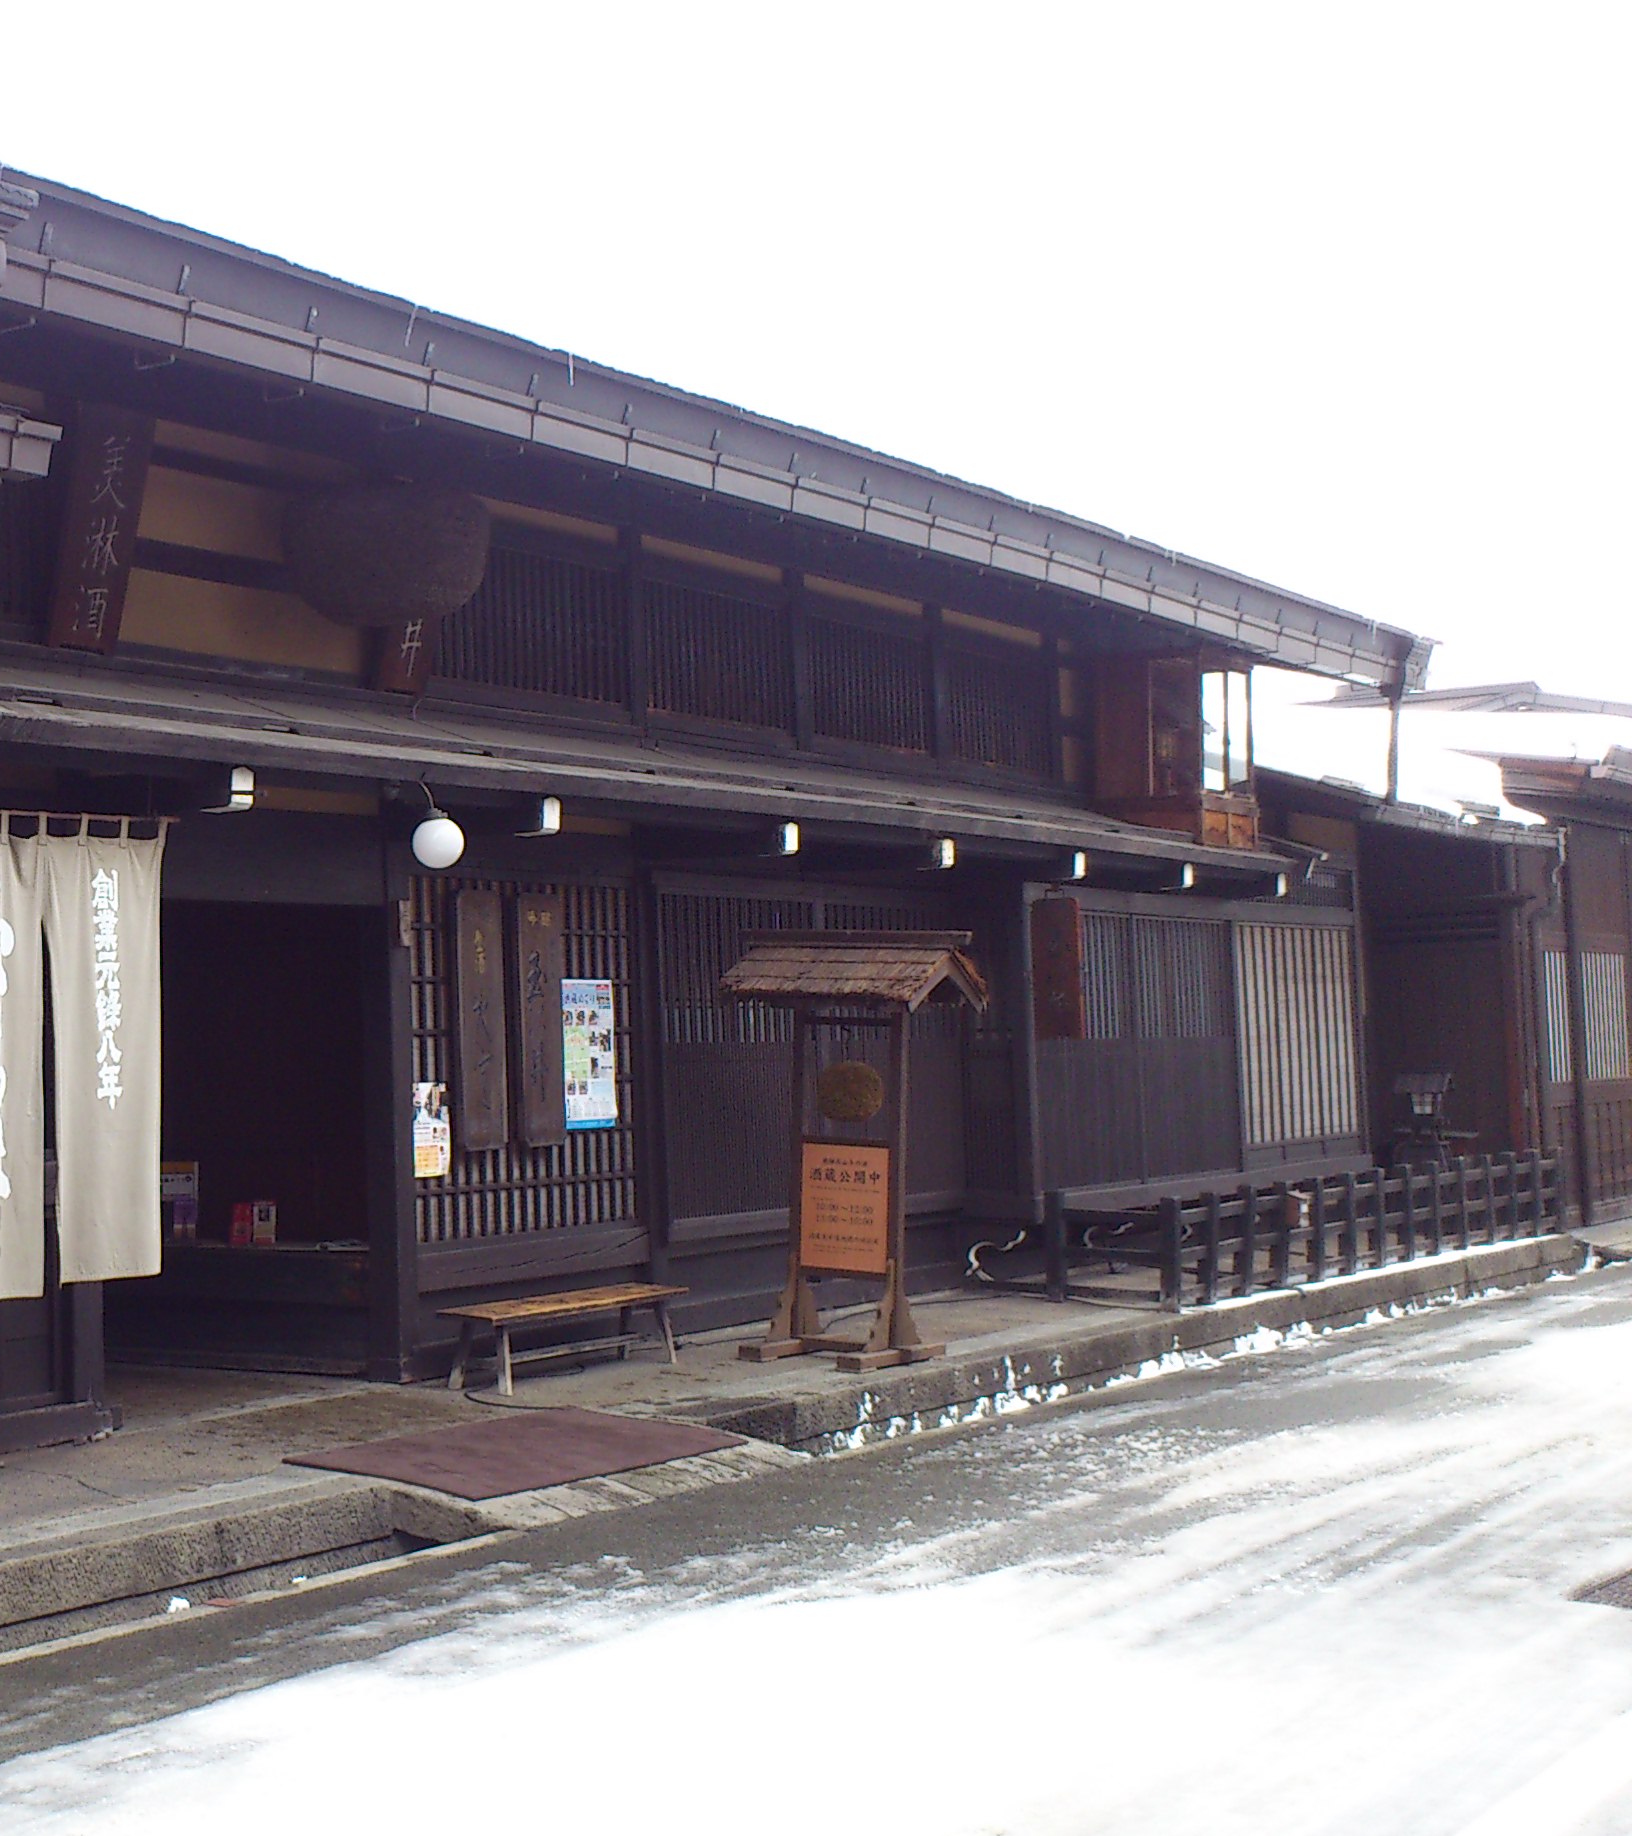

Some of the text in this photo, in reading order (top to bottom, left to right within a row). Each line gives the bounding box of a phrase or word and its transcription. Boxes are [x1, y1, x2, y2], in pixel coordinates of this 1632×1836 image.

[809, 1167, 881, 1185] 酒蔵公開中
